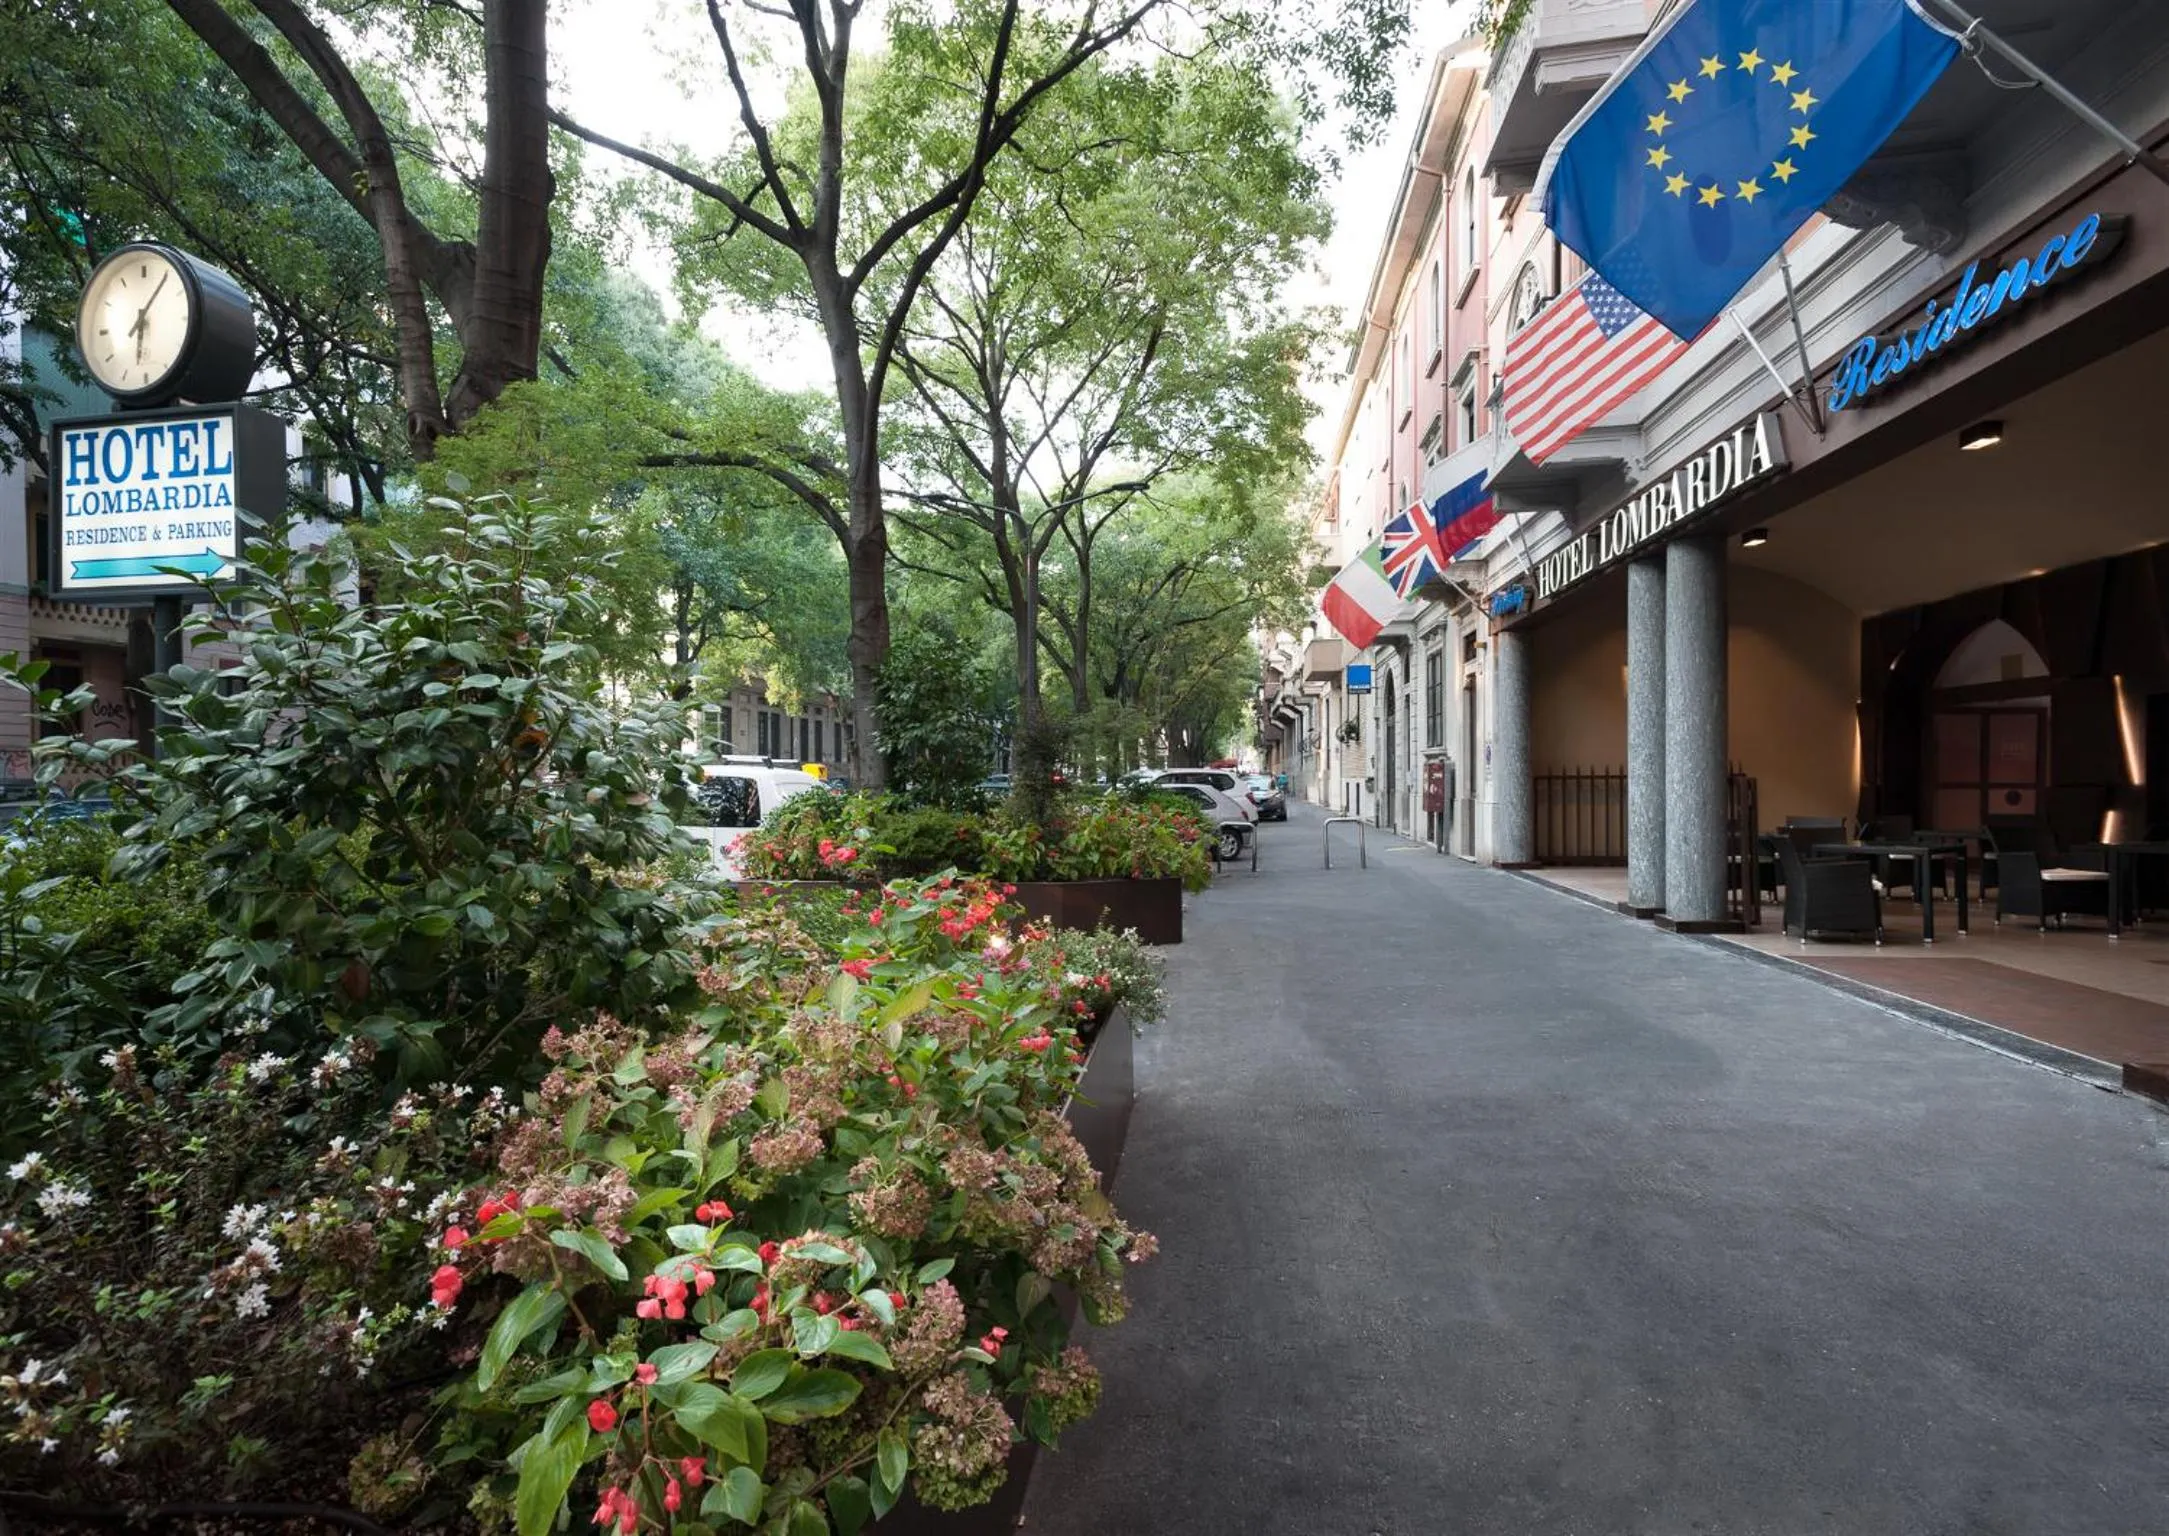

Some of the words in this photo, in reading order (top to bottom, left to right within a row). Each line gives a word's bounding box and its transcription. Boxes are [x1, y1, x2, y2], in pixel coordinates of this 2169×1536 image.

[1828, 212, 2100, 412] Residence
[66, 421, 232, 487] HOTEL
[66, 482, 232, 517] LOMBARDIA
[1539, 533, 1593, 600] HOTEL
[1600, 412, 1774, 564] LOMBARDIA
[66, 525, 147, 546] RESIDENCE
[152, 527, 162, 541] &
[168, 520, 232, 540] PARKING
